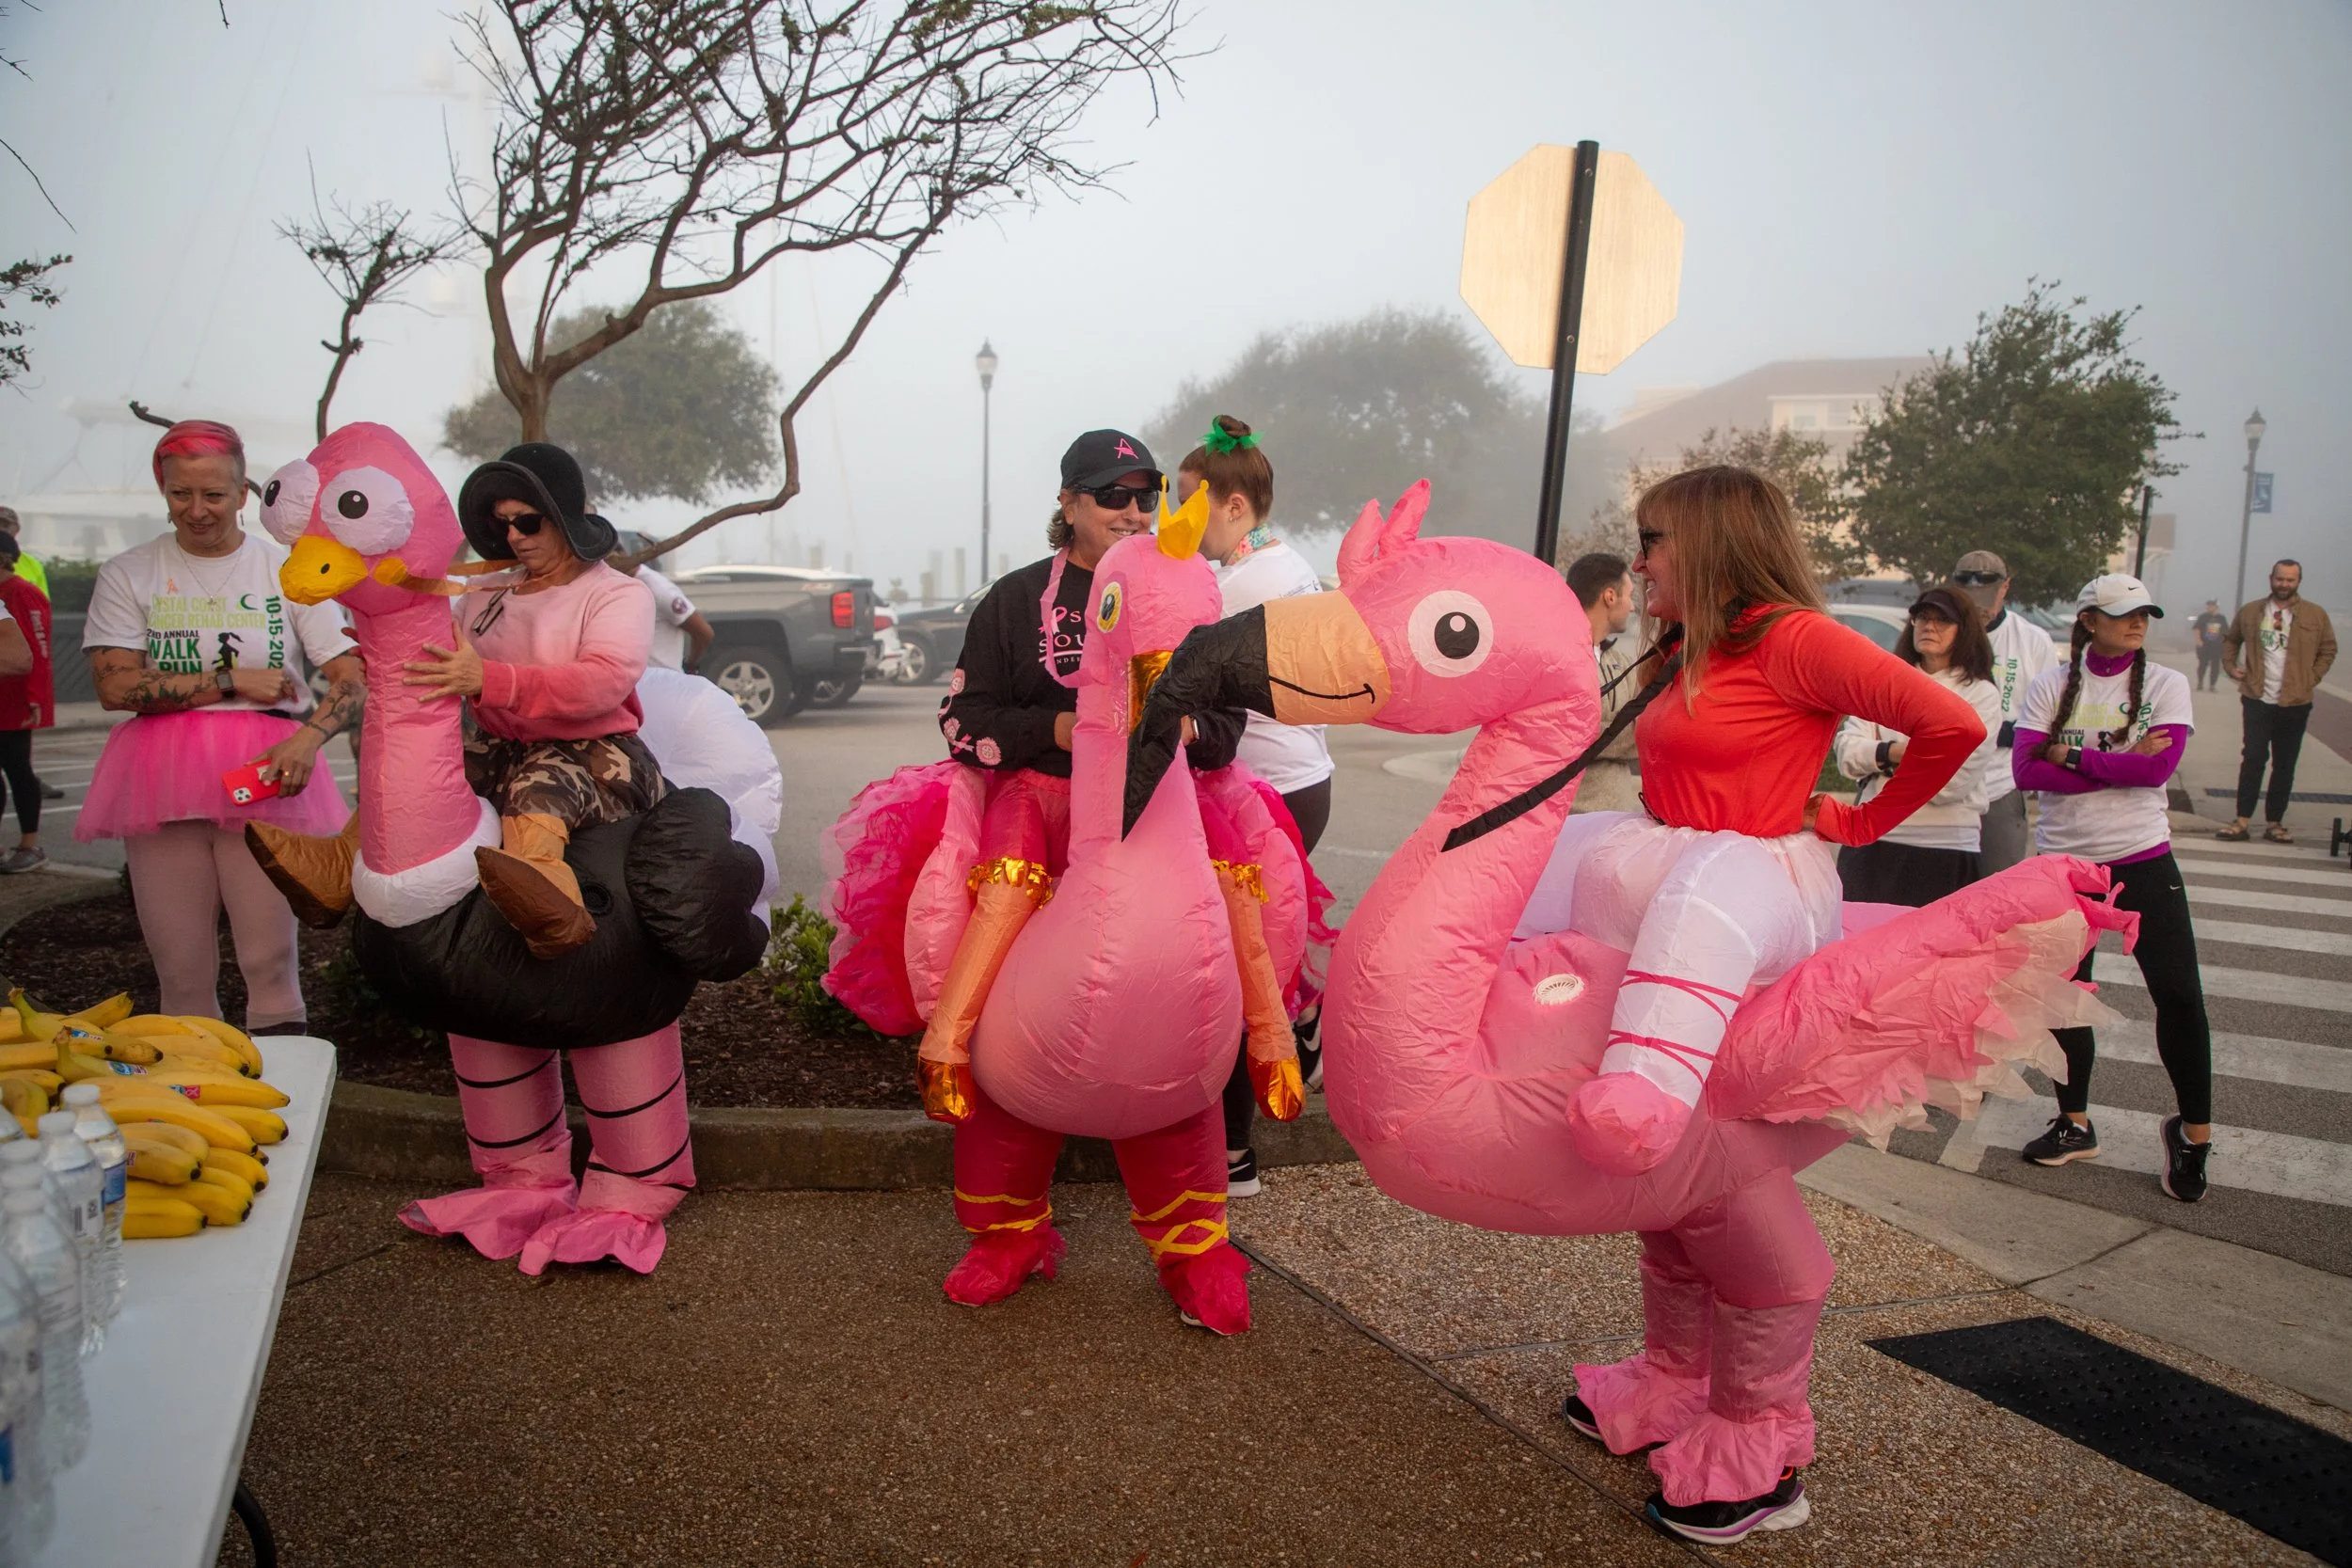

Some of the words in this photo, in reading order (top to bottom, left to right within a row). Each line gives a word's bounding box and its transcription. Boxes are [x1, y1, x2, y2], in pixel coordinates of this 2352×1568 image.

[164, 629, 200, 639] ANNUAL
[188, 613, 224, 627] REHAB
[227, 613, 266, 628] CENTER
[265, 595, 284, 669] 10-15-202
[2002, 658, 2018, 712] 10-15-2022
[2137, 702, 2153, 741] 10-15-2
[2060, 736, 2085, 747] ALK
